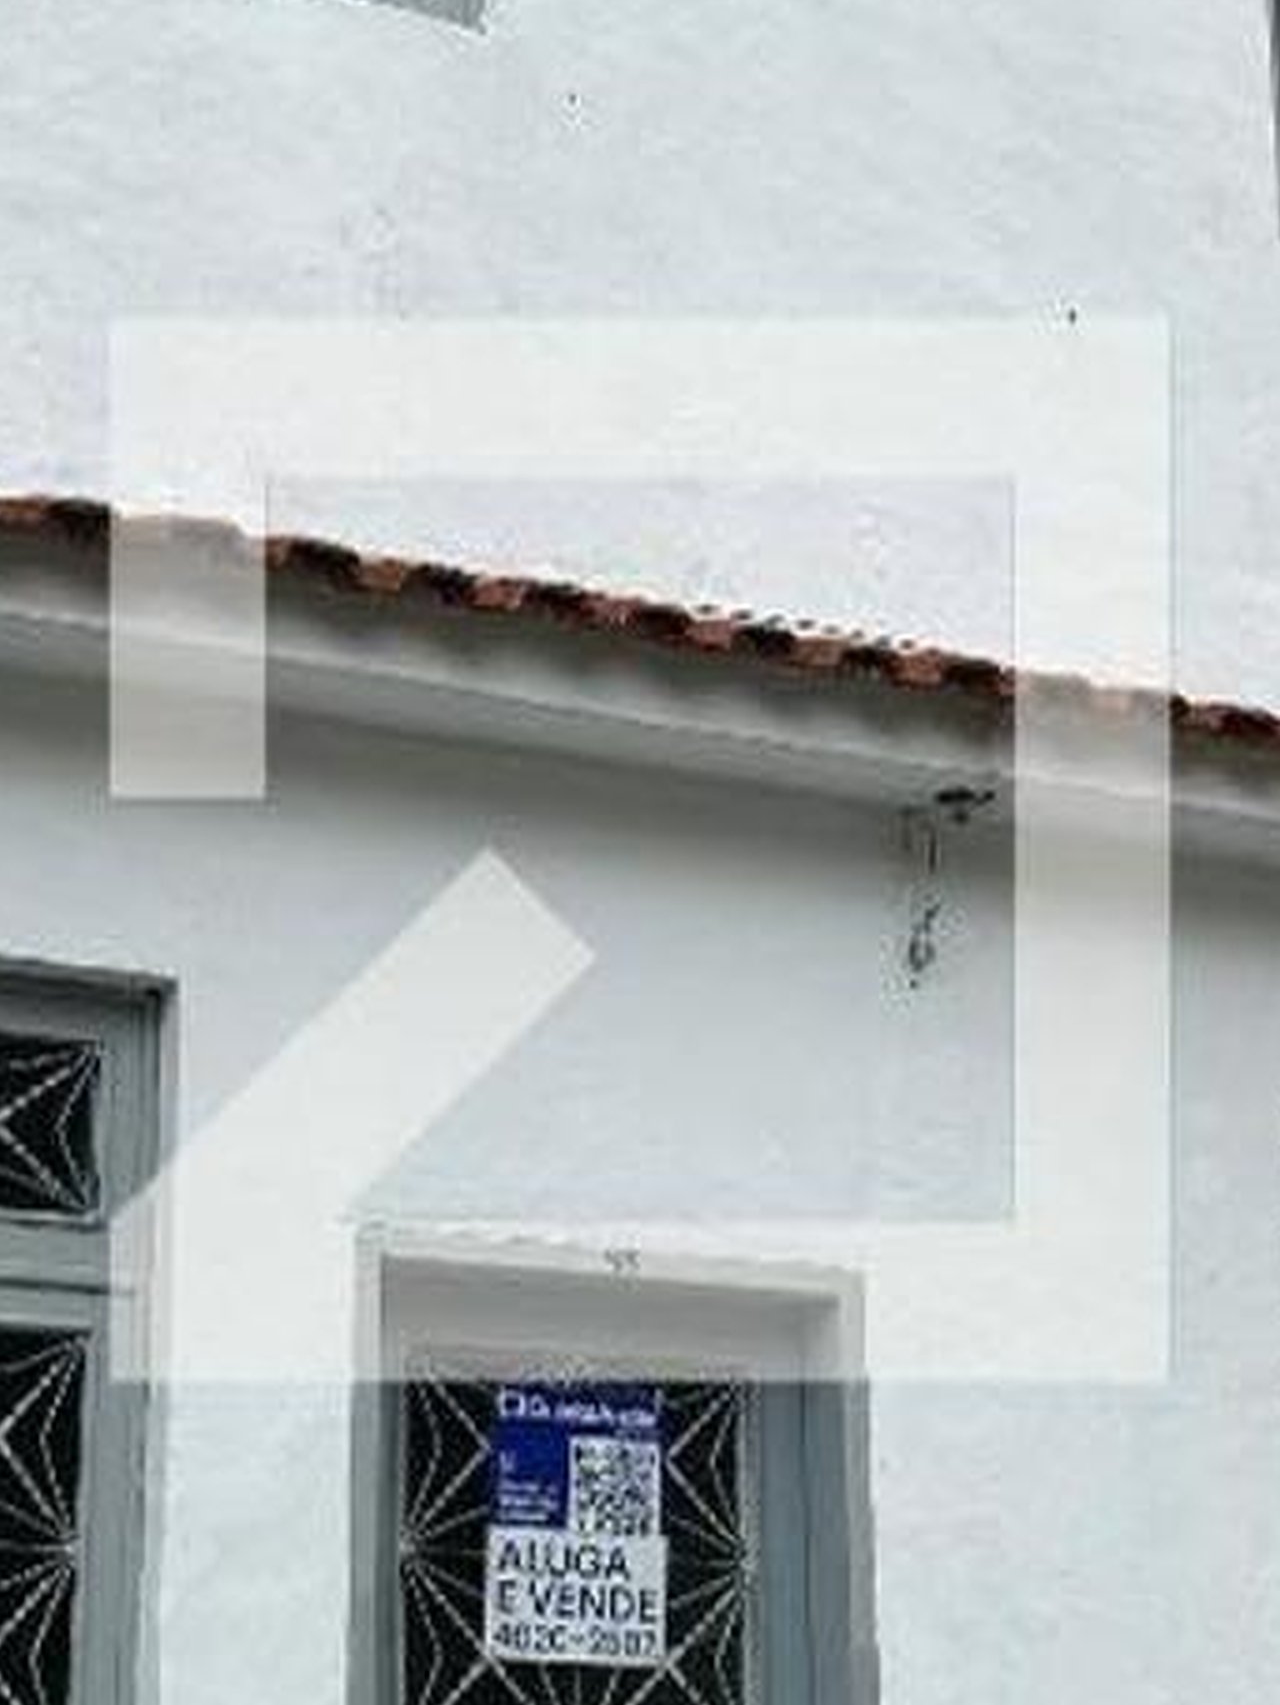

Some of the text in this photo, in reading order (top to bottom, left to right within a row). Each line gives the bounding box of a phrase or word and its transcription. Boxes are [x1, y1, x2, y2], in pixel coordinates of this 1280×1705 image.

[497, 1539, 631, 1581] ALUGA
[498, 1578, 658, 1624] E VENDE
